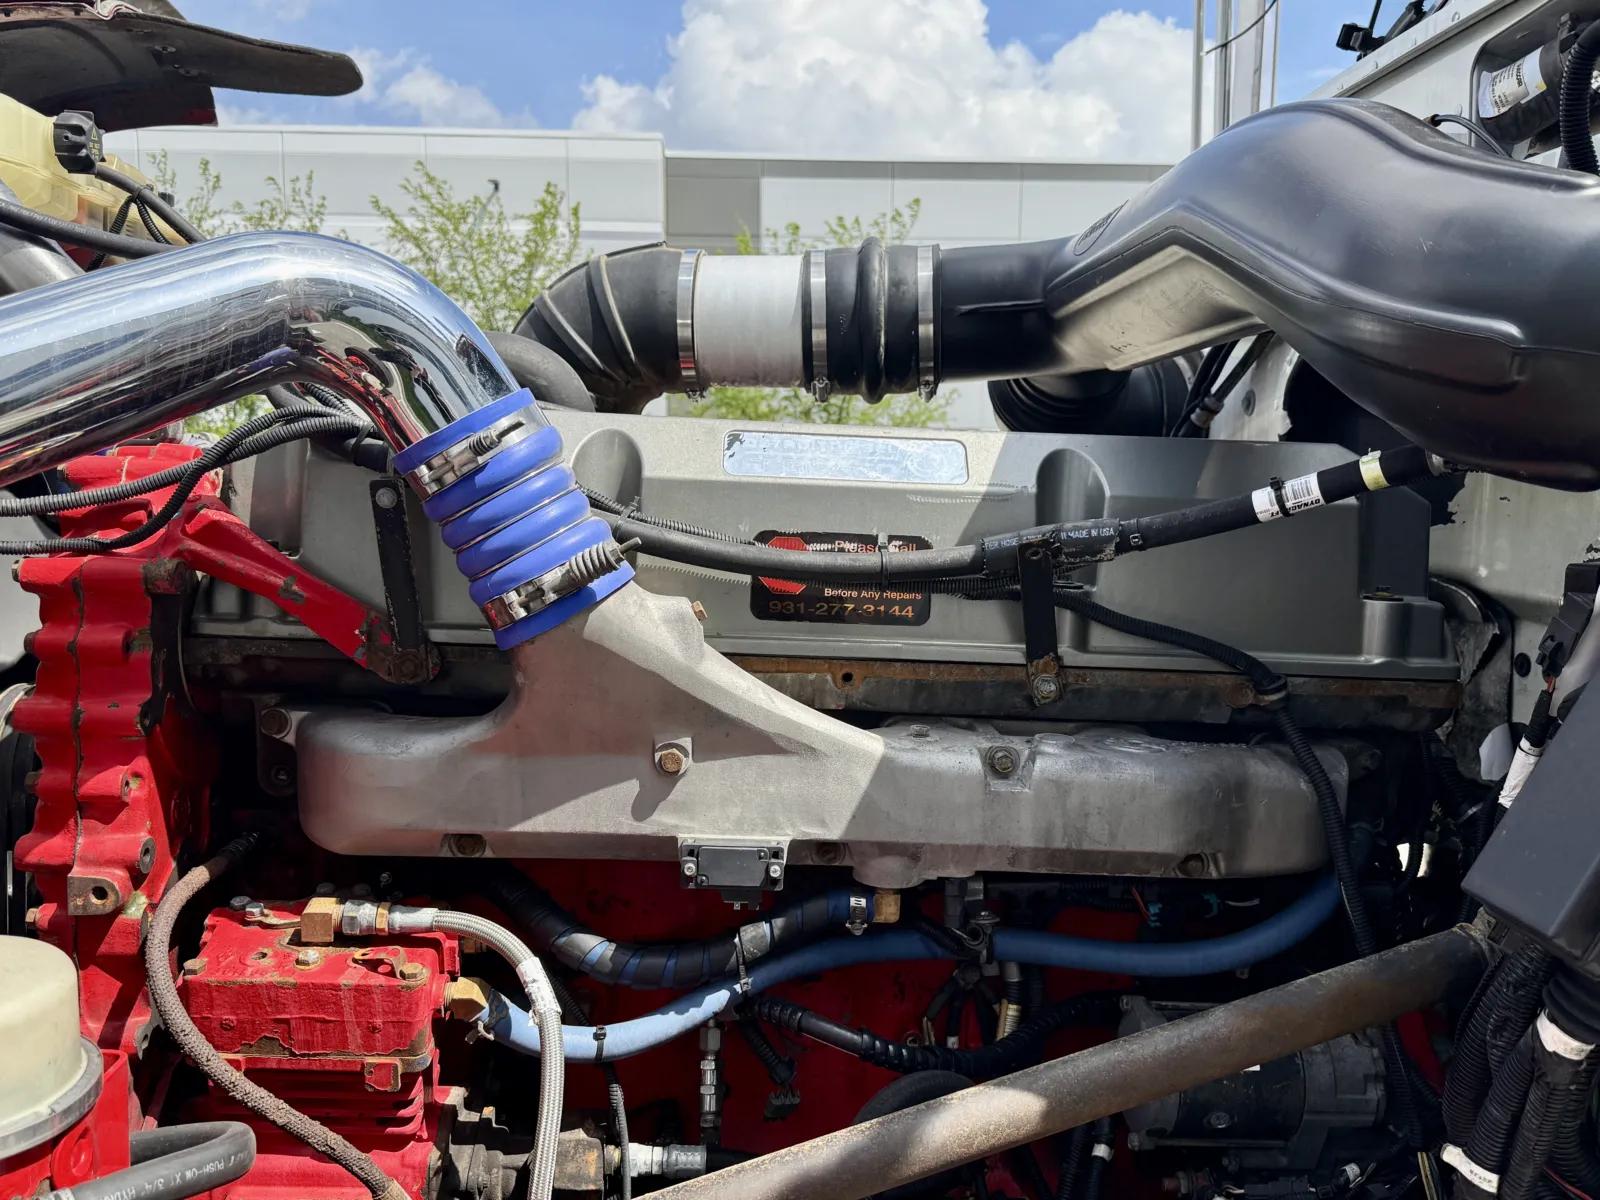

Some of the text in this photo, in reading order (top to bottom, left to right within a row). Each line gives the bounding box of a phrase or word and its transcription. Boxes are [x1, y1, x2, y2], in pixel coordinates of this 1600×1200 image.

[1271, 499, 1320, 517] DYNACFT
[1100, 527, 1114, 536] USA
[824, 588, 922, 601] Before Any Repairs
[768, 601, 915, 618] 931-277-3144
[185, 1160, 225, 1180] PUSH-ON
